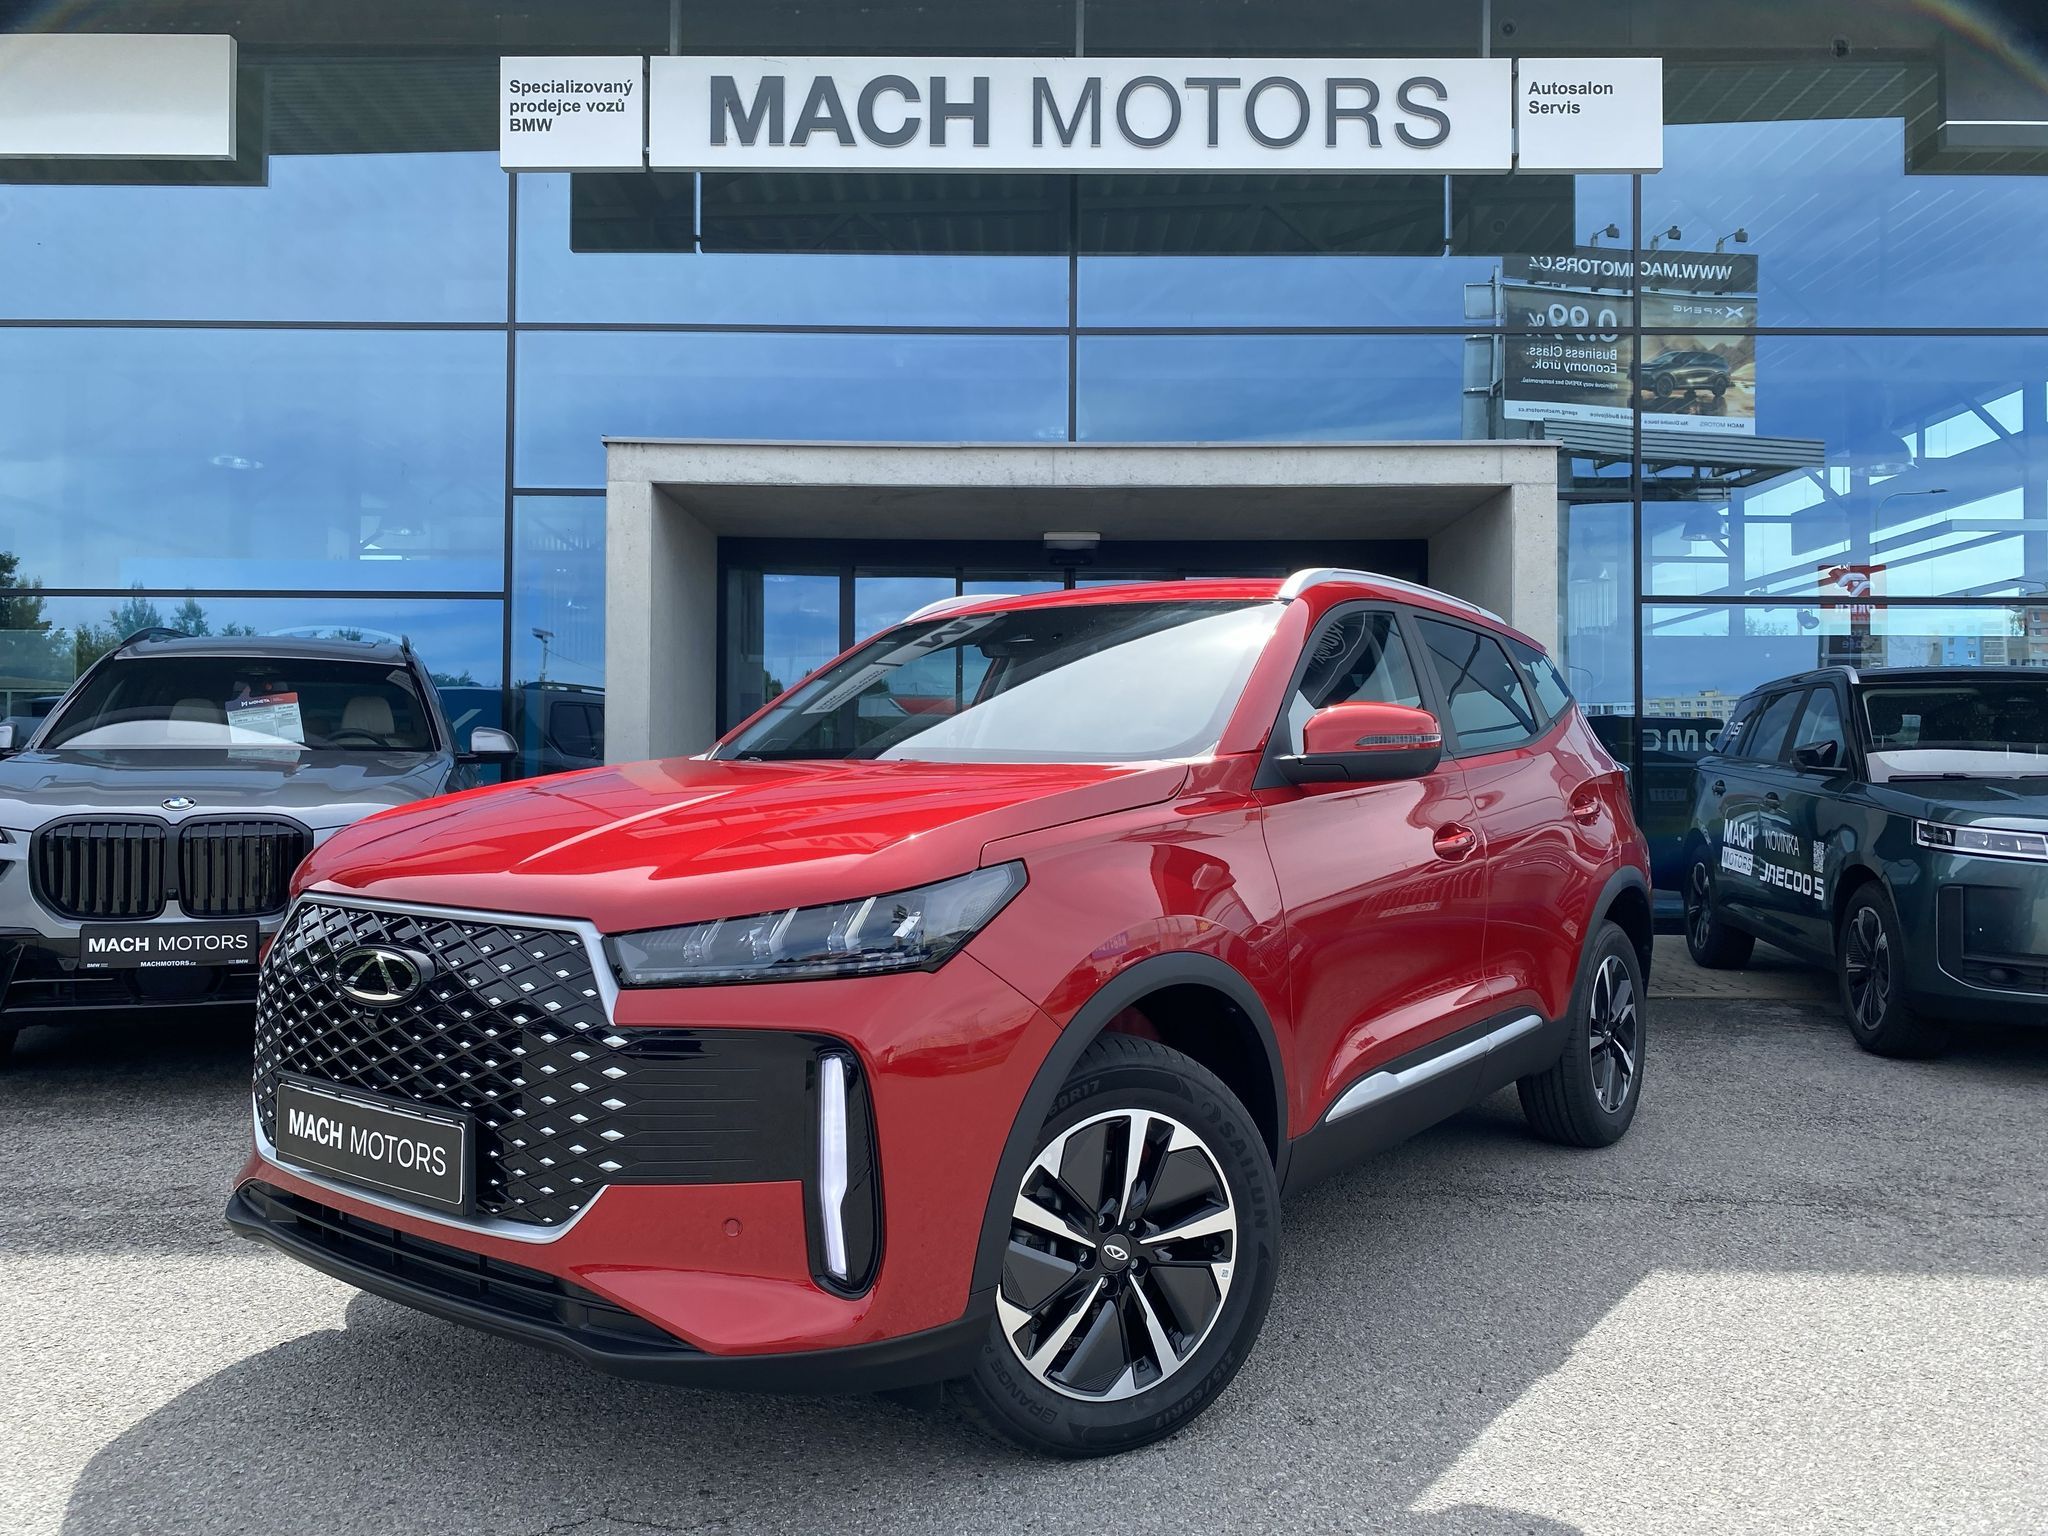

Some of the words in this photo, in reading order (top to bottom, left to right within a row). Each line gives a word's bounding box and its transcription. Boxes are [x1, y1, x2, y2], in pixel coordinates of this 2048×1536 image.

[509, 79, 634, 98] Specializovaný
[1527, 80, 1614, 96] Autosalon
[509, 98, 581, 116] prodejce
[586, 97, 626, 114] vozů
[709, 74, 990, 148] MACH
[1032, 75, 1452, 149] MOTORS
[1528, 100, 1581, 115] Servis
[509, 118, 553, 132] BMW
[1723, 818, 1754, 850] MACH
[1765, 829, 1800, 857] NOVINKA
[1723, 850, 1752, 873] MOTORS
[1759, 862, 1812, 896] JAECOO
[1813, 876, 1824, 901] 5
[88, 936, 149, 953] MACH
[158, 934, 249, 951] MOTORS
[288, 1108, 343, 1150] MACH
[350, 1125, 447, 1176] MOTORS
[1218, 1120, 1270, 1230] SAILUN
